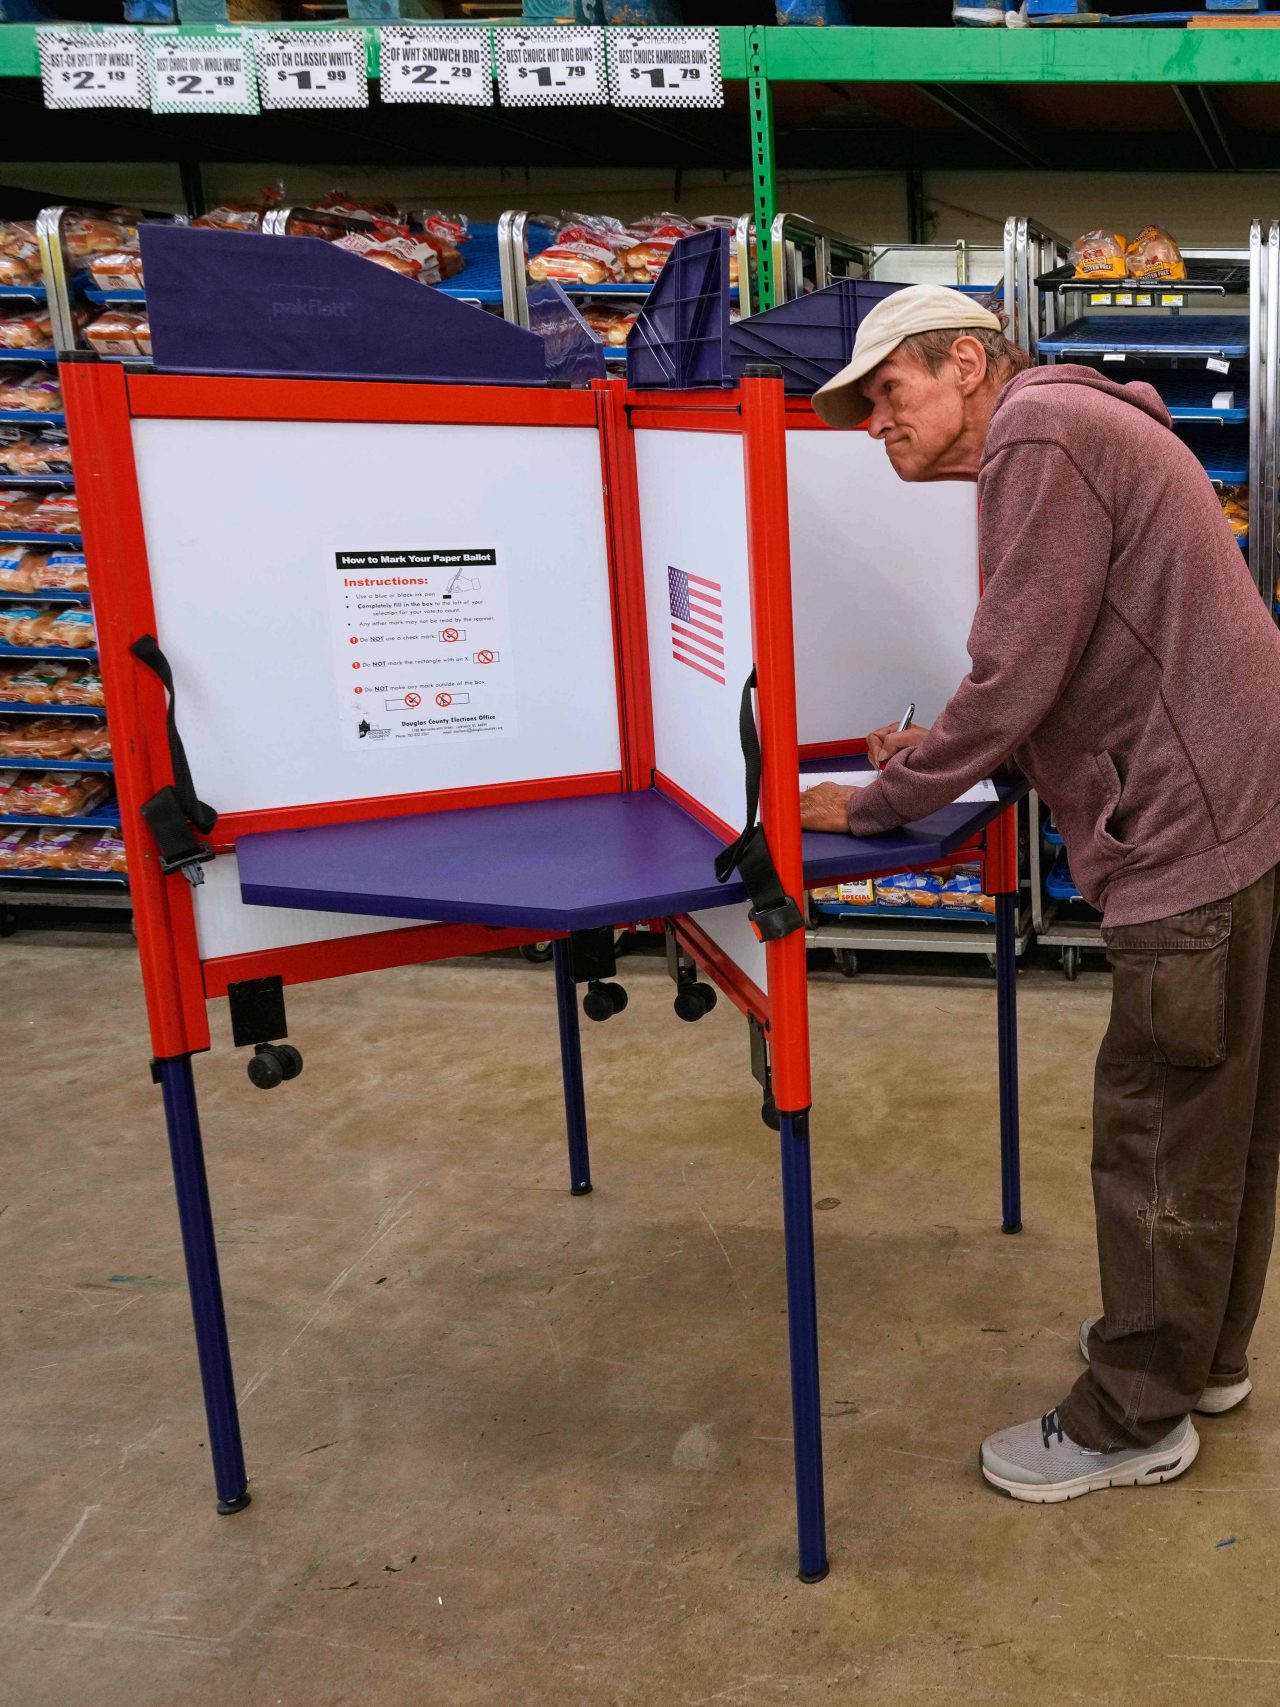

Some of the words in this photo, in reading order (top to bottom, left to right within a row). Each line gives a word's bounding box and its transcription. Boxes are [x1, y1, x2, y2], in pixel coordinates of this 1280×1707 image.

[266, 52, 280, 66] BST
[281, 52, 293, 66] CH
[294, 52, 328, 66] CLASSIC
[328, 52, 353, 66] WHITE
[390, 48, 400, 61] OF
[402, 48, 421, 61] WHT
[422, 48, 460, 62] SNDWCH
[462, 49, 480, 63] BRD
[506, 49, 522, 63] BEST
[522, 48, 546, 62] CHOICE
[547, 48, 559, 62] HOT
[561, 48, 574, 62] DOG
[575, 47, 592, 61] BUNS
[618, 50, 633, 64] BEST
[633, 50, 654, 64] CHOICE
[655, 50, 690, 64] HAMBURGER
[691, 50, 708, 64] BUNS
[62, 71, 125, 90] $2.19
[277, 70, 346, 90] $1.99
[401, 65, 472, 85] $2.29
[518, 66, 586, 86] $1.79
[630, 68, 700, 88] $1.79
[167, 75, 234, 94] $2.19
[342, 556, 365, 564] How
[432, 554, 461, 563] Paper
[344, 577, 428, 586] Instructions:
